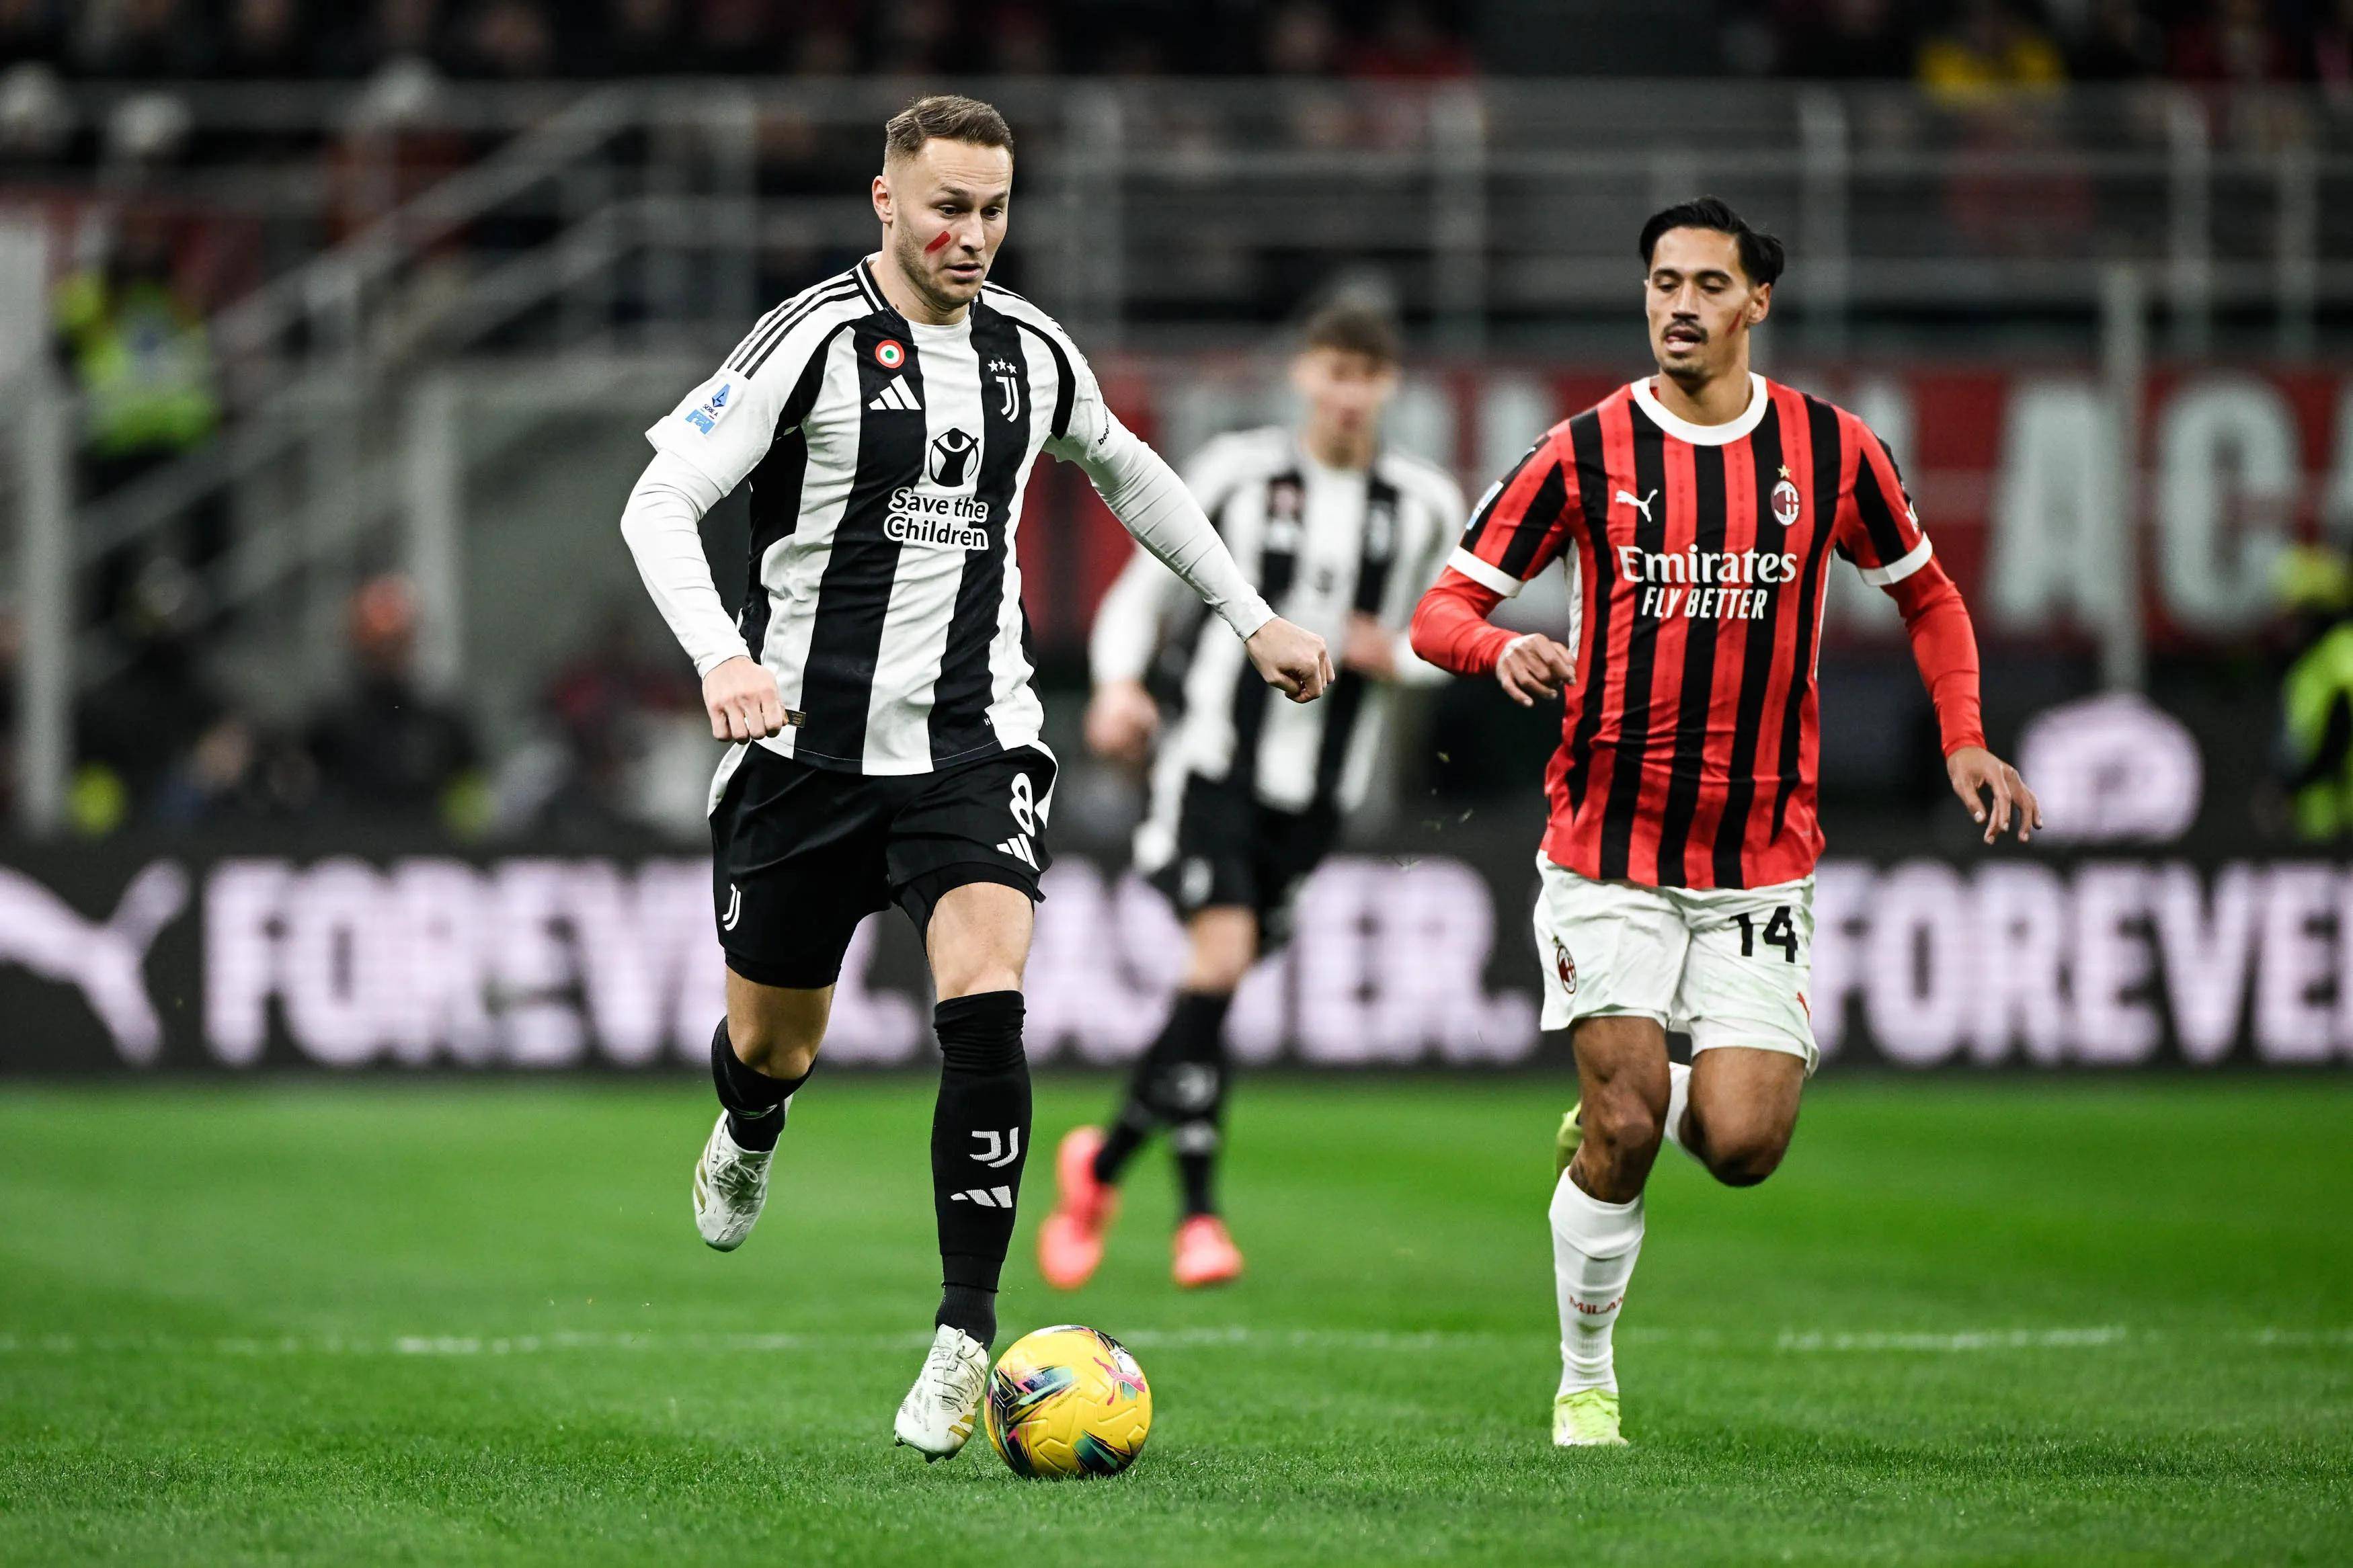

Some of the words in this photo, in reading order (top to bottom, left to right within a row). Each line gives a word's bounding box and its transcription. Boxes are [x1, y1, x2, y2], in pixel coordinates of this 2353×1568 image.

[891, 488, 949, 515] Save
[954, 497, 986, 520] the
[887, 515, 986, 547] Children
[1616, 543, 1798, 583] Emirates
[1641, 586, 1682, 618] FLY
[1683, 587, 1769, 620] BETTER
[1009, 772, 1035, 837] 8
[1728, 905, 1798, 964] 14
[1808, 857, 2353, 1067] FOREVE
